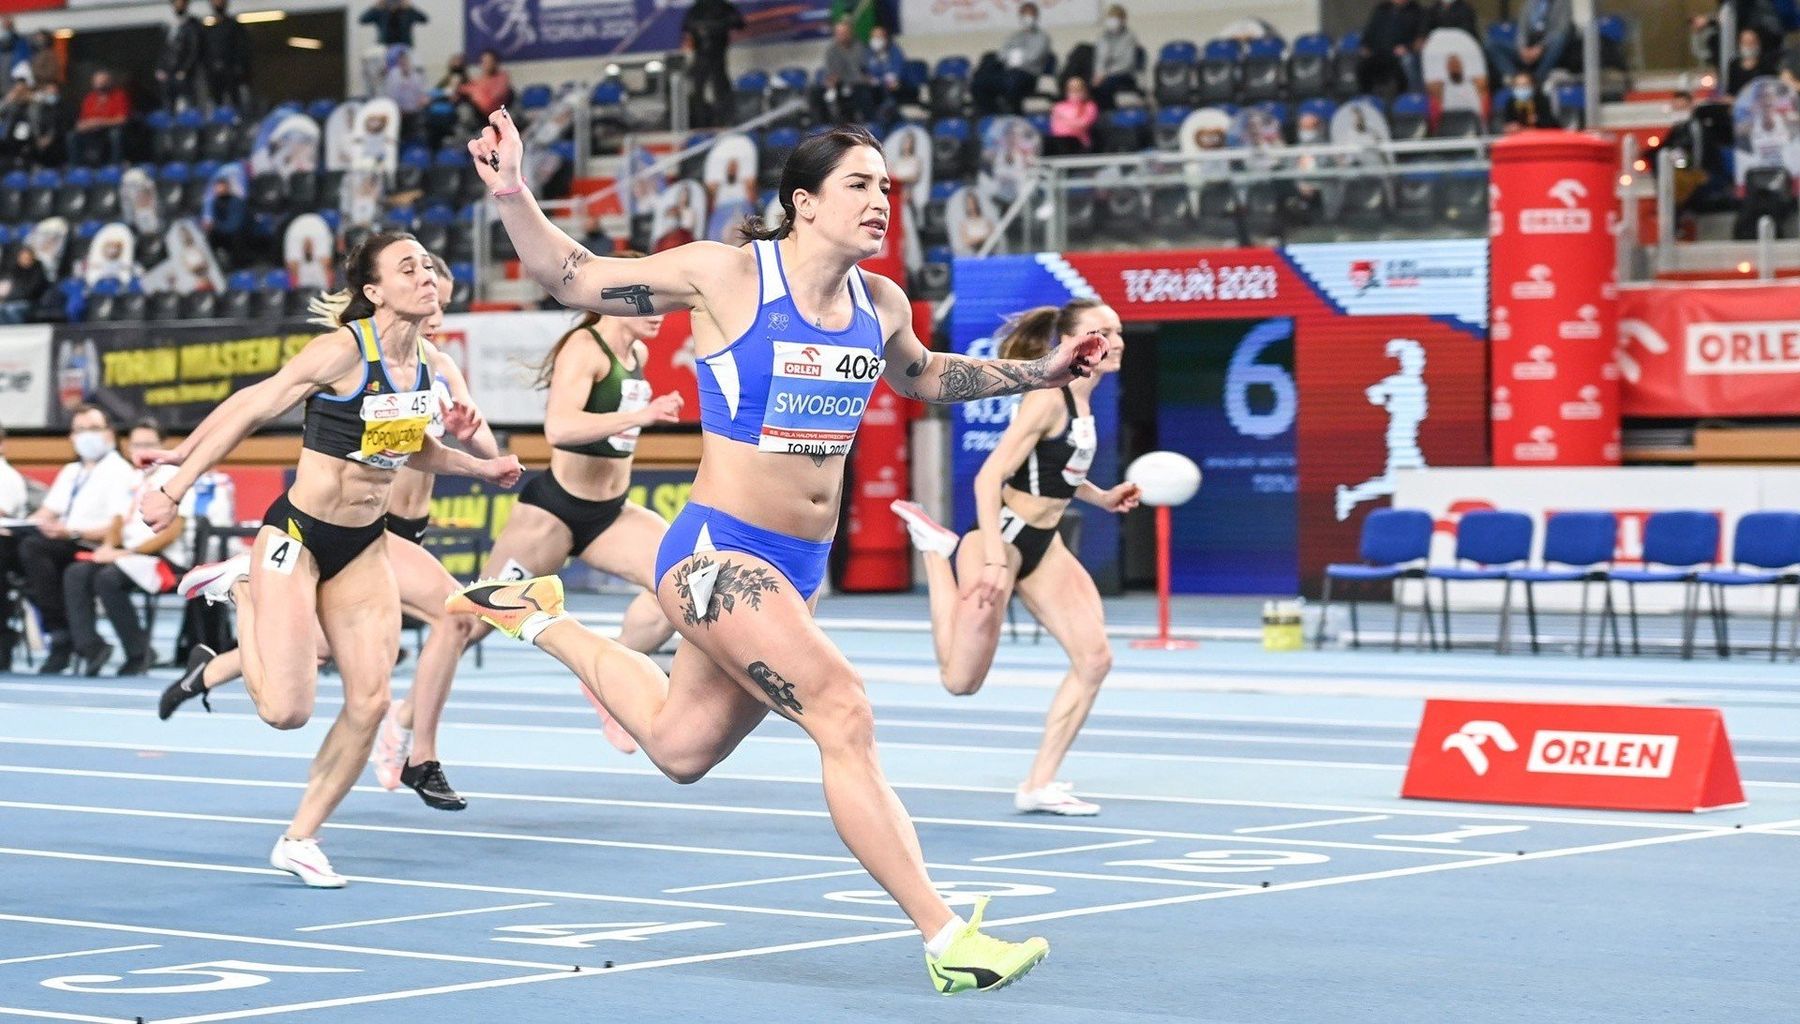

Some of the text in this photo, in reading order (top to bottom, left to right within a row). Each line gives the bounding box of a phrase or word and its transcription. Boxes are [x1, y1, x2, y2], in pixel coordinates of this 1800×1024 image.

[785, 364, 820, 376] ORLEN
[836, 354, 880, 380] 408
[1224, 317, 1297, 440] 6
[411, 395, 427, 415] 45
[774, 392, 864, 417] SWOBOD
[788, 442, 826, 455] TORUŃ
[271, 541, 290, 568] 4
[1542, 739, 1664, 769] ORLEN
[1373, 824, 1530, 843] 1
[1104, 849, 1330, 873] 2
[823, 881, 1056, 906] 3
[490, 920, 727, 948] 4
[40, 960, 365, 994] 5
